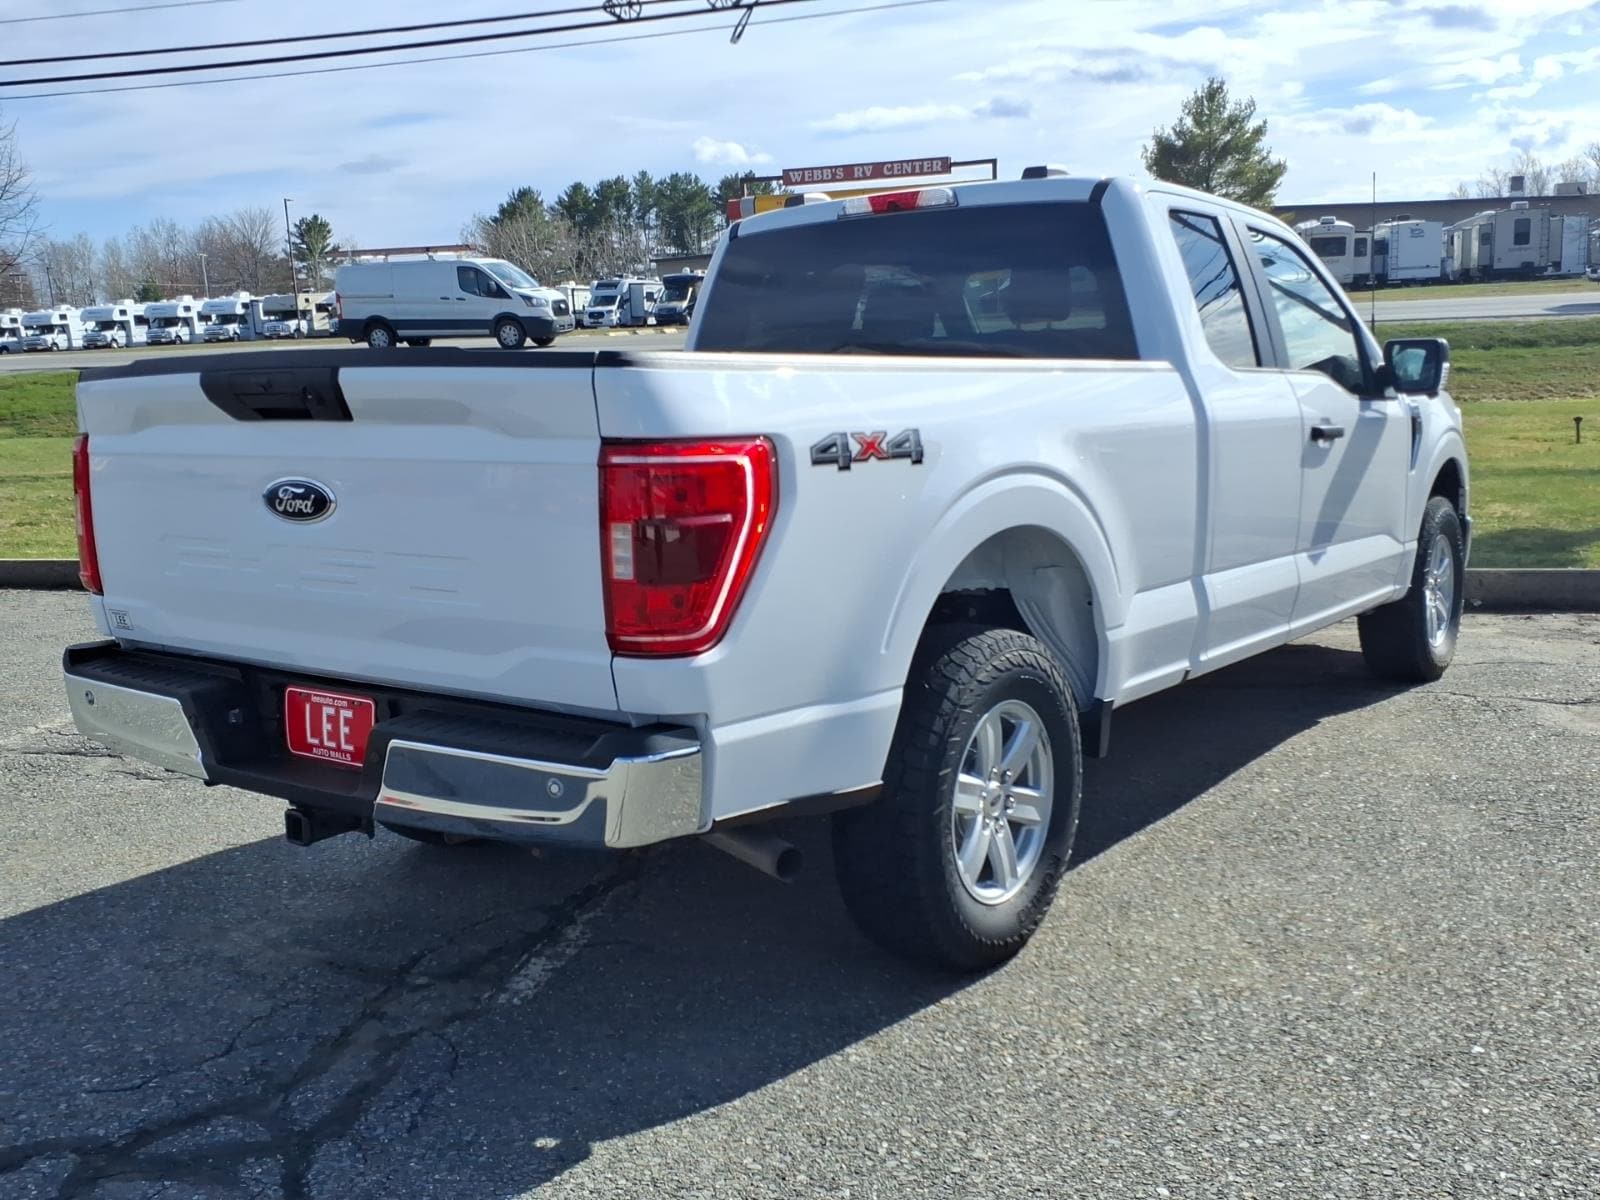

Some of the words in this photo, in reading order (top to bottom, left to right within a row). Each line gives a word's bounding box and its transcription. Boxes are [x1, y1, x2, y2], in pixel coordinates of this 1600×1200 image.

[789, 167, 844, 183] WEBB'S
[854, 165, 873, 178] RV
[883, 159, 943, 176] CENTER
[275, 486, 315, 513] Ford
[305, 702, 354, 752] LEE
[312, 747, 330, 757] AUTO
[330, 750, 352, 761] MALLS
